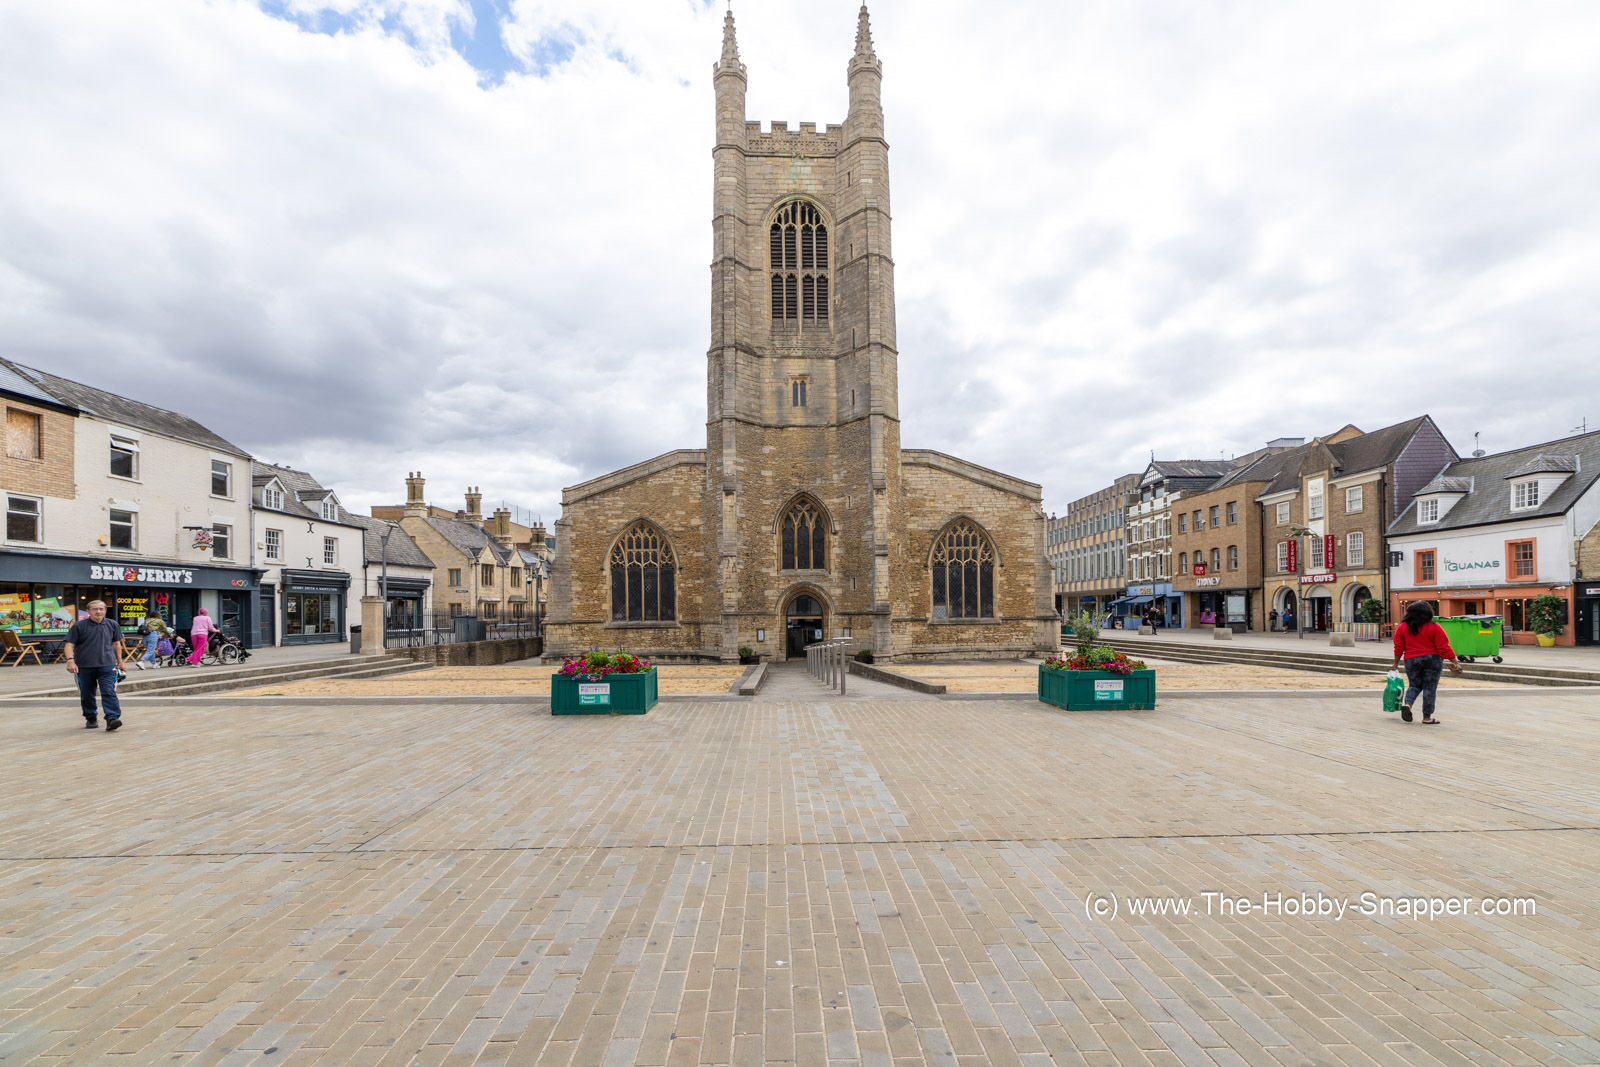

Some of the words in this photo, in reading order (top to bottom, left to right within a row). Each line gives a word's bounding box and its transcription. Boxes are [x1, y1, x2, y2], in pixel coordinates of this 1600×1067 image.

[1445, 560, 1500, 571] IGUANAS
[90, 565, 124, 580] BEN
[137, 568, 192, 584] JERRY'S
[1314, 574, 1334, 582] GUYS
